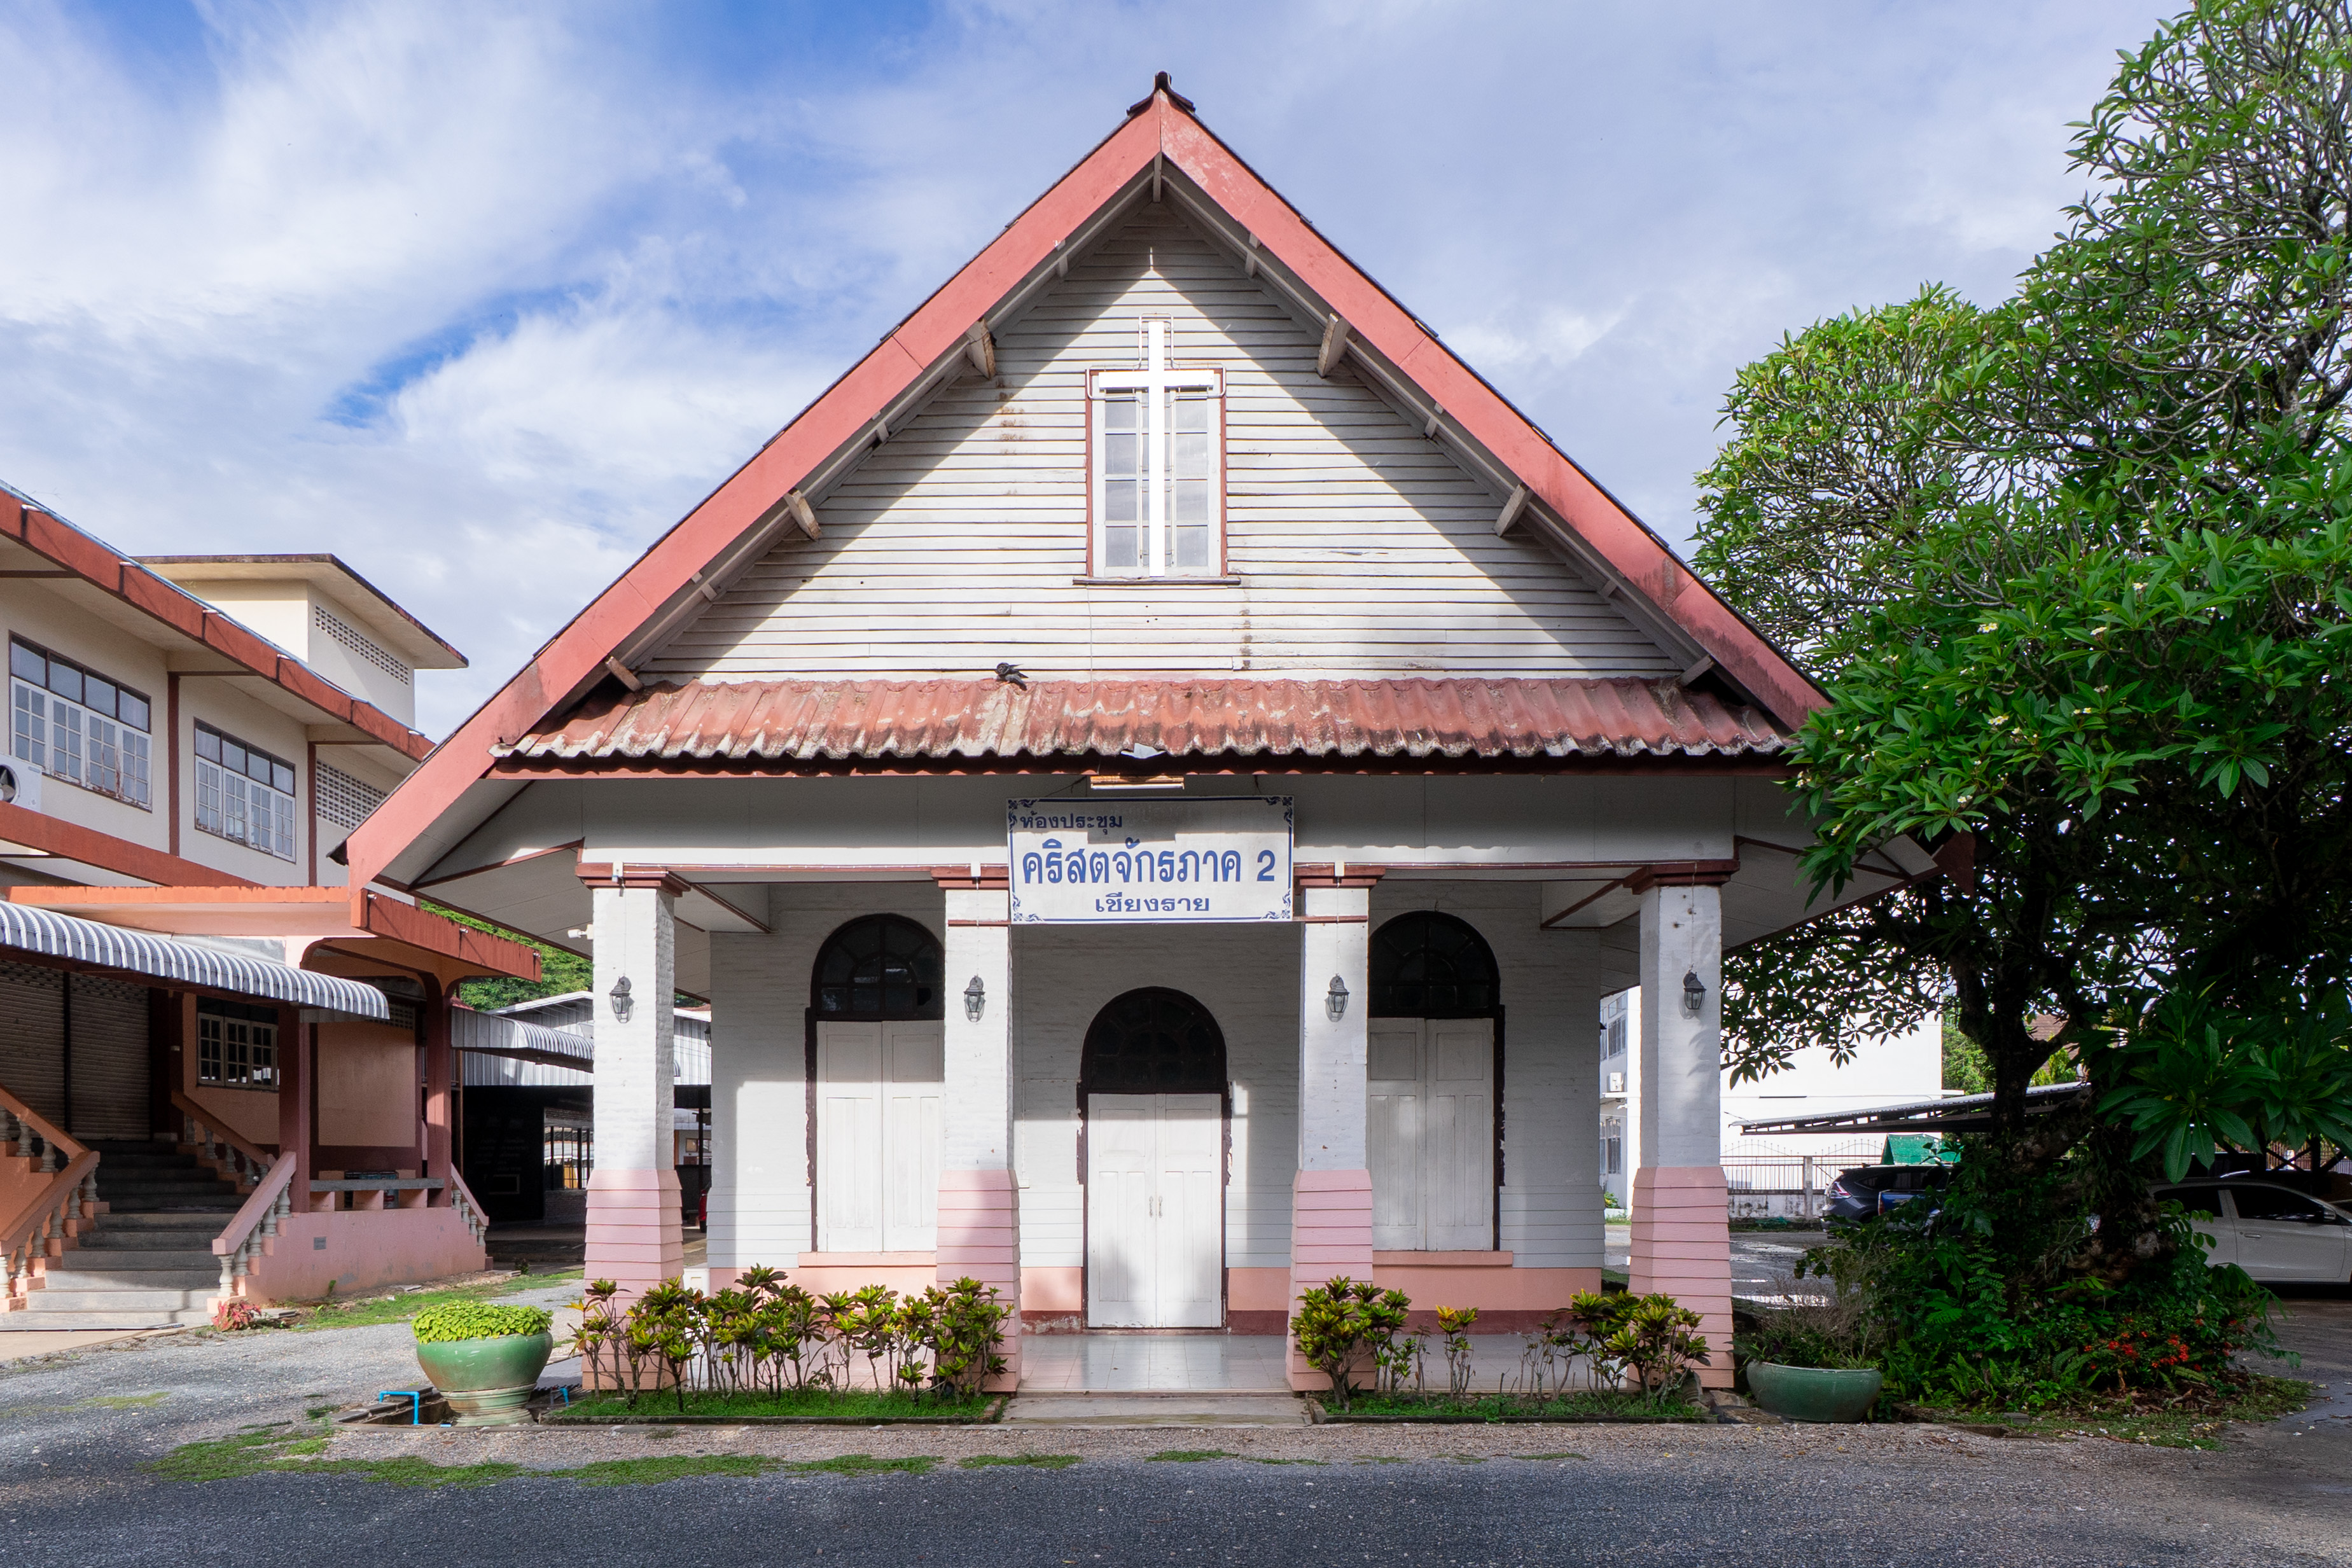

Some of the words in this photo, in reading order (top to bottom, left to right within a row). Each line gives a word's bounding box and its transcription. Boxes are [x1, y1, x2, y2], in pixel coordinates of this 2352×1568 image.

[1020, 810, 1123, 835] ห้องประชุม
[1022, 836, 1241, 884] คริสตจักรภาค
[1256, 849, 1276, 882] 2
[1096, 891, 1209, 912] เชียงราย
